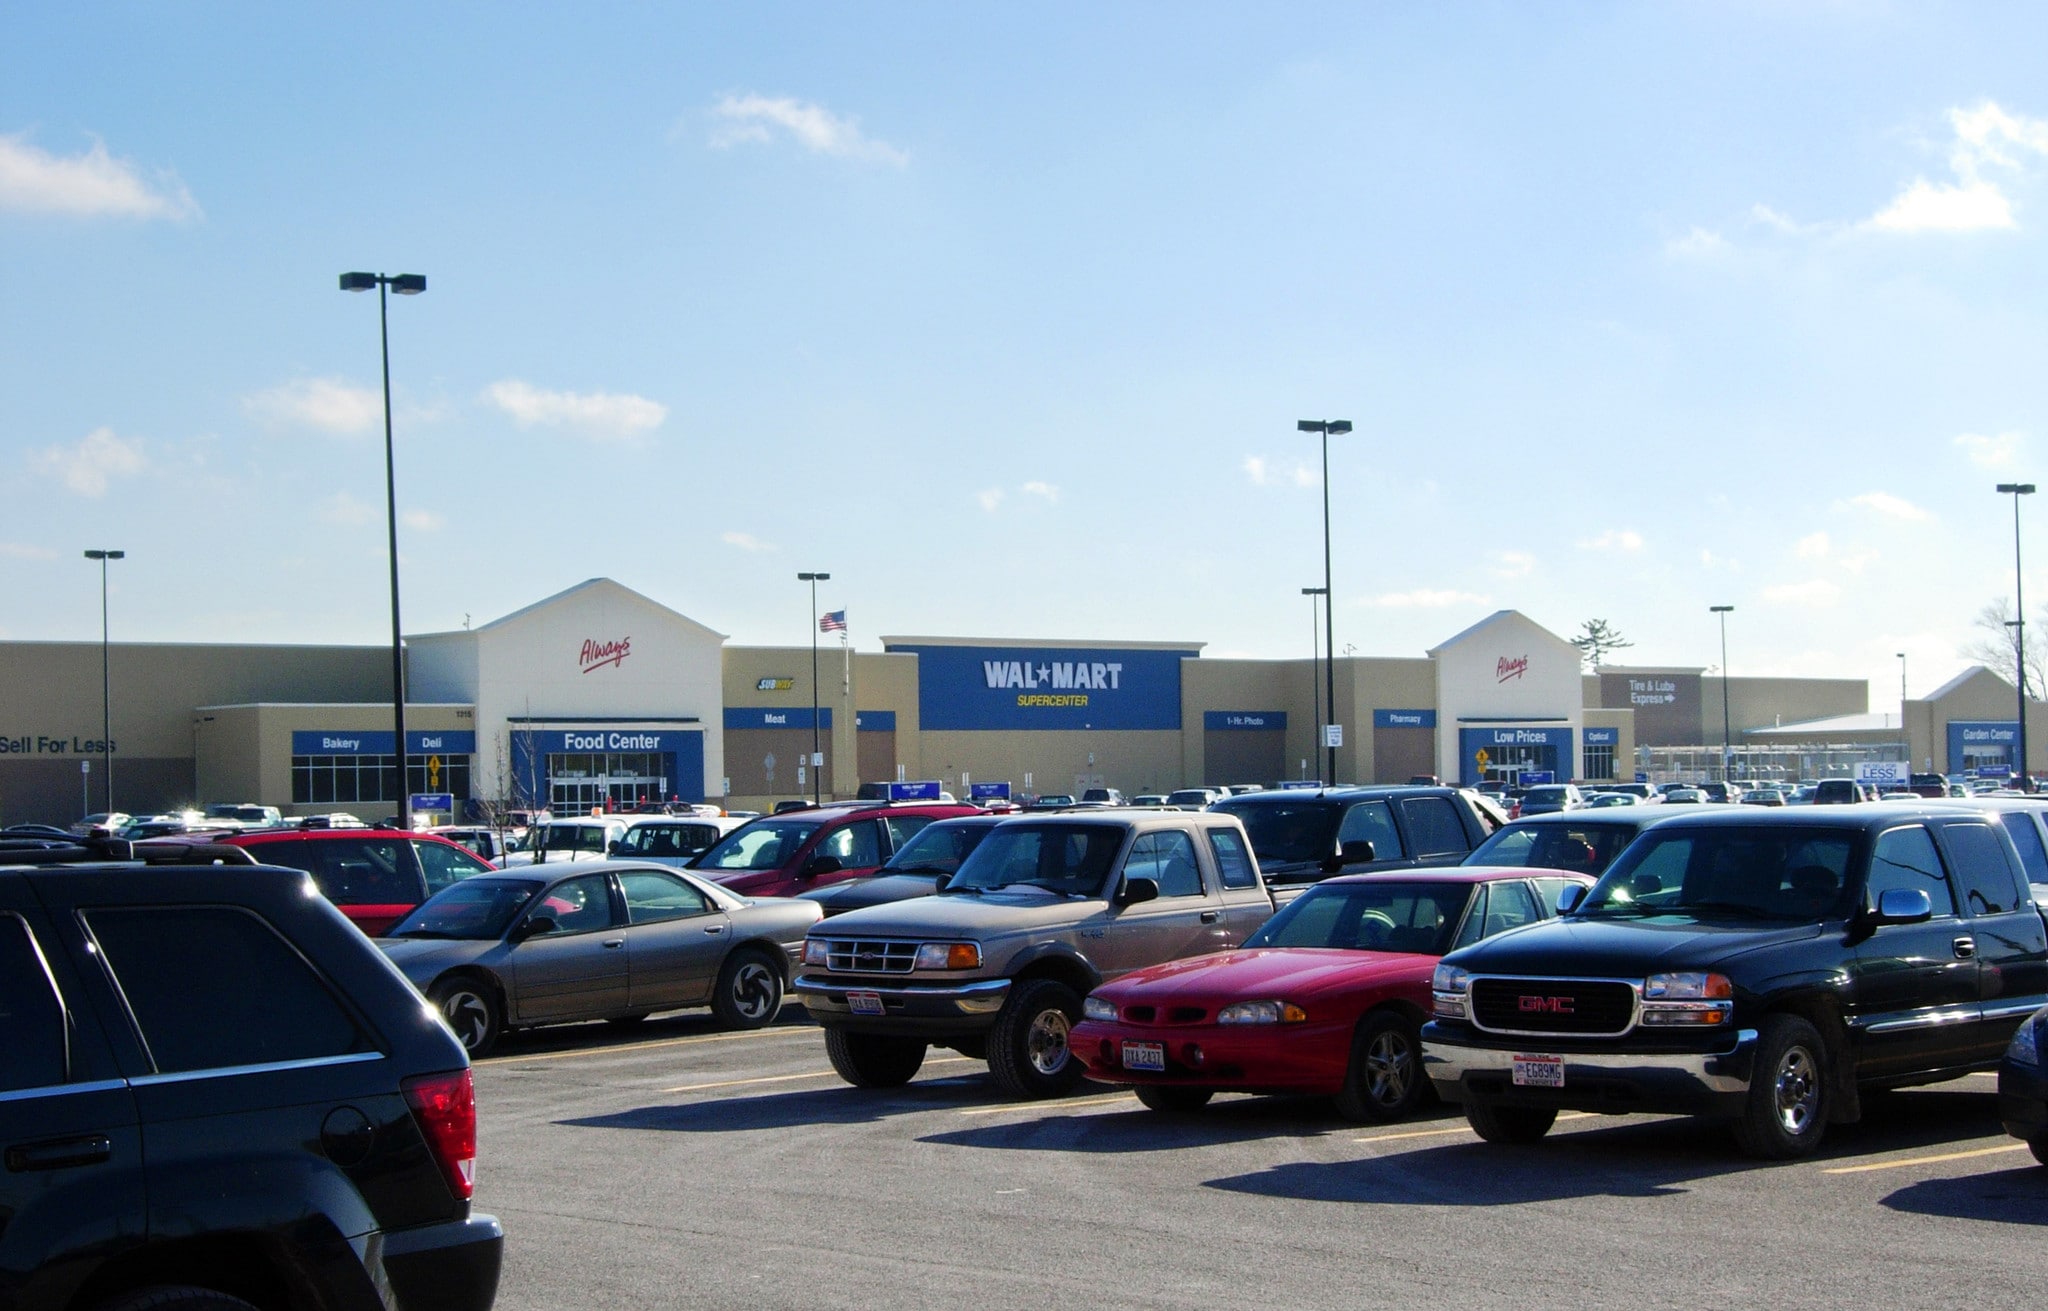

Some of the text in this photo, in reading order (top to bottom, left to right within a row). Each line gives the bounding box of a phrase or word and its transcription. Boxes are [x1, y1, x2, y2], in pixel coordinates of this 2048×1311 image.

[579, 636, 631, 674] Always
[1496, 654, 1528, 683] Always
[1629, 679, 1645, 691] Tire
[1655, 680, 1675, 691] Lube
[1017, 695, 1088, 706] SUPERCENTER
[1631, 692, 1664, 706] Express
[764, 714, 786, 724] Meat
[1244, 716, 1264, 725] Photo
[1390, 714, 1421, 724] Pharmacy
[1494, 730, 1547, 743] Low Prices
[1963, 728, 2014, 740] Garden Center
[0, 736, 116, 753] Sell For Less
[322, 738, 360, 751] Bakery
[422, 738, 442, 748] Deli
[564, 732, 660, 749] Food Center
[1862, 768, 1897, 779] LESS!
[1518, 996, 1575, 1013] GMC
